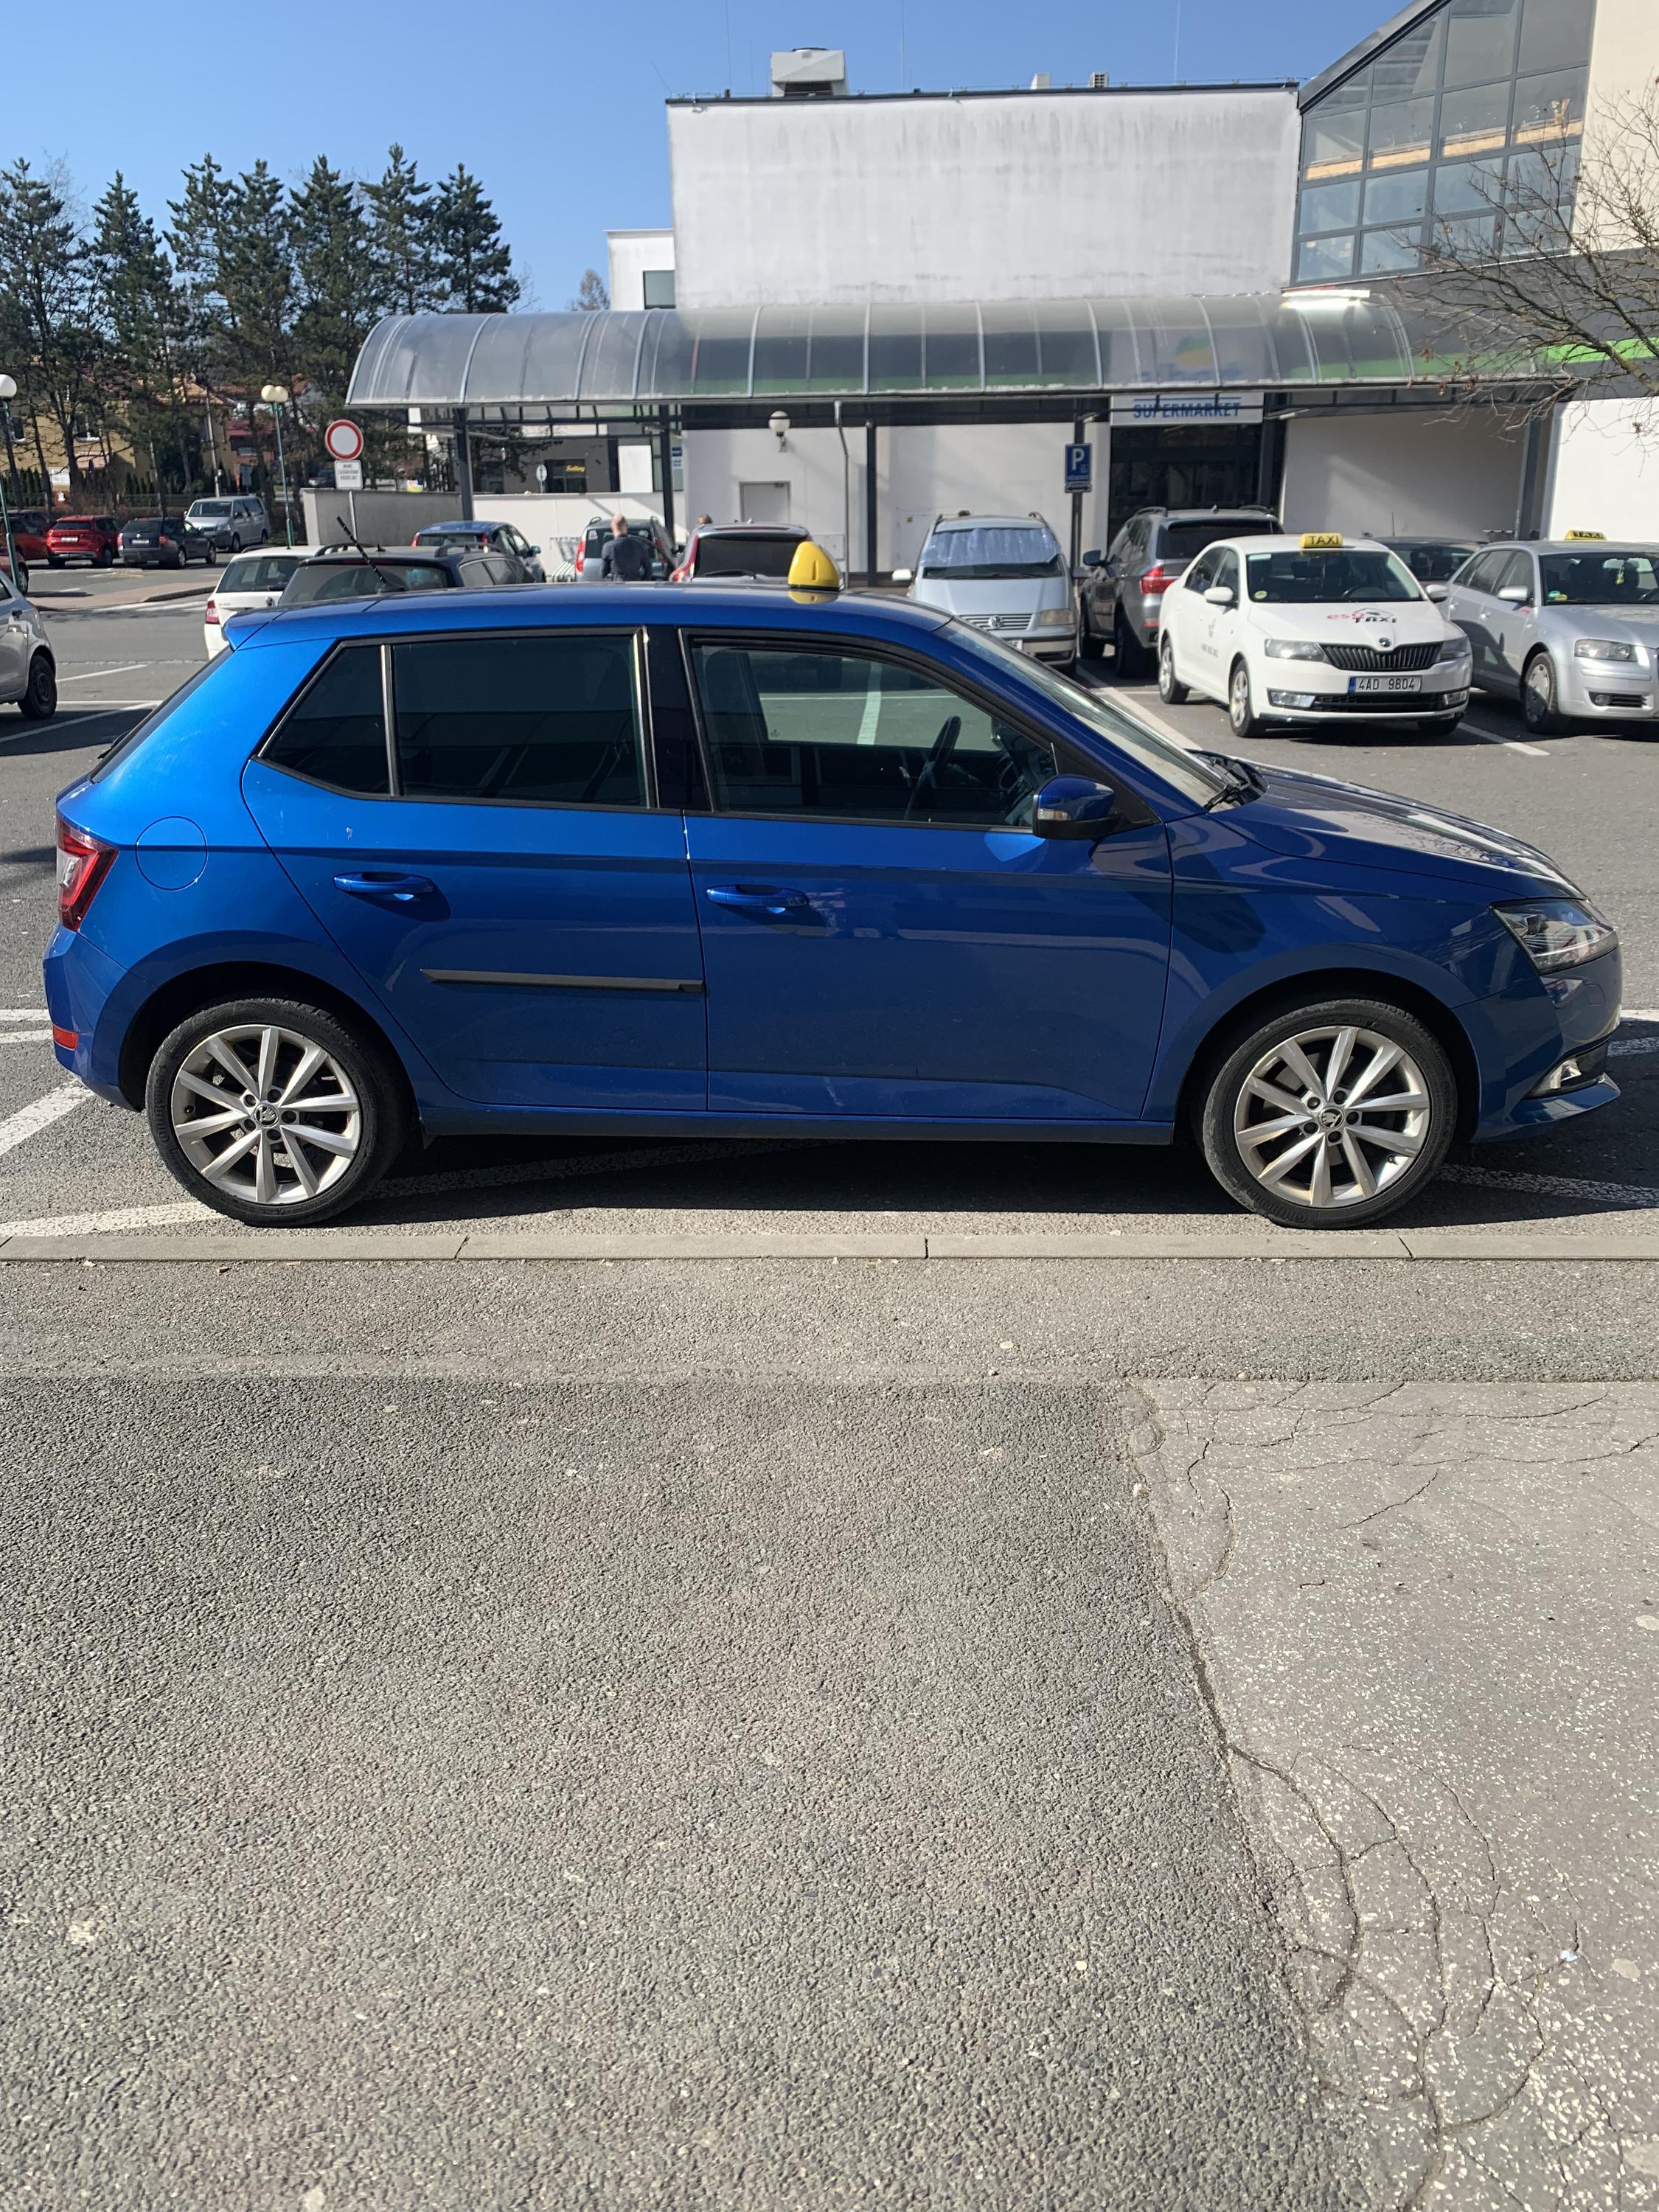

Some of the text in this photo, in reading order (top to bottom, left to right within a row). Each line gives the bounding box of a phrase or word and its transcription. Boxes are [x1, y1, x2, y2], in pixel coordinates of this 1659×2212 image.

[1133, 402, 1241, 418] SUPERMARKET
[1072, 448, 1085, 470] P
[1308, 535, 1339, 545] TAXI
[1358, 677, 1416, 691] 4AD 9804
